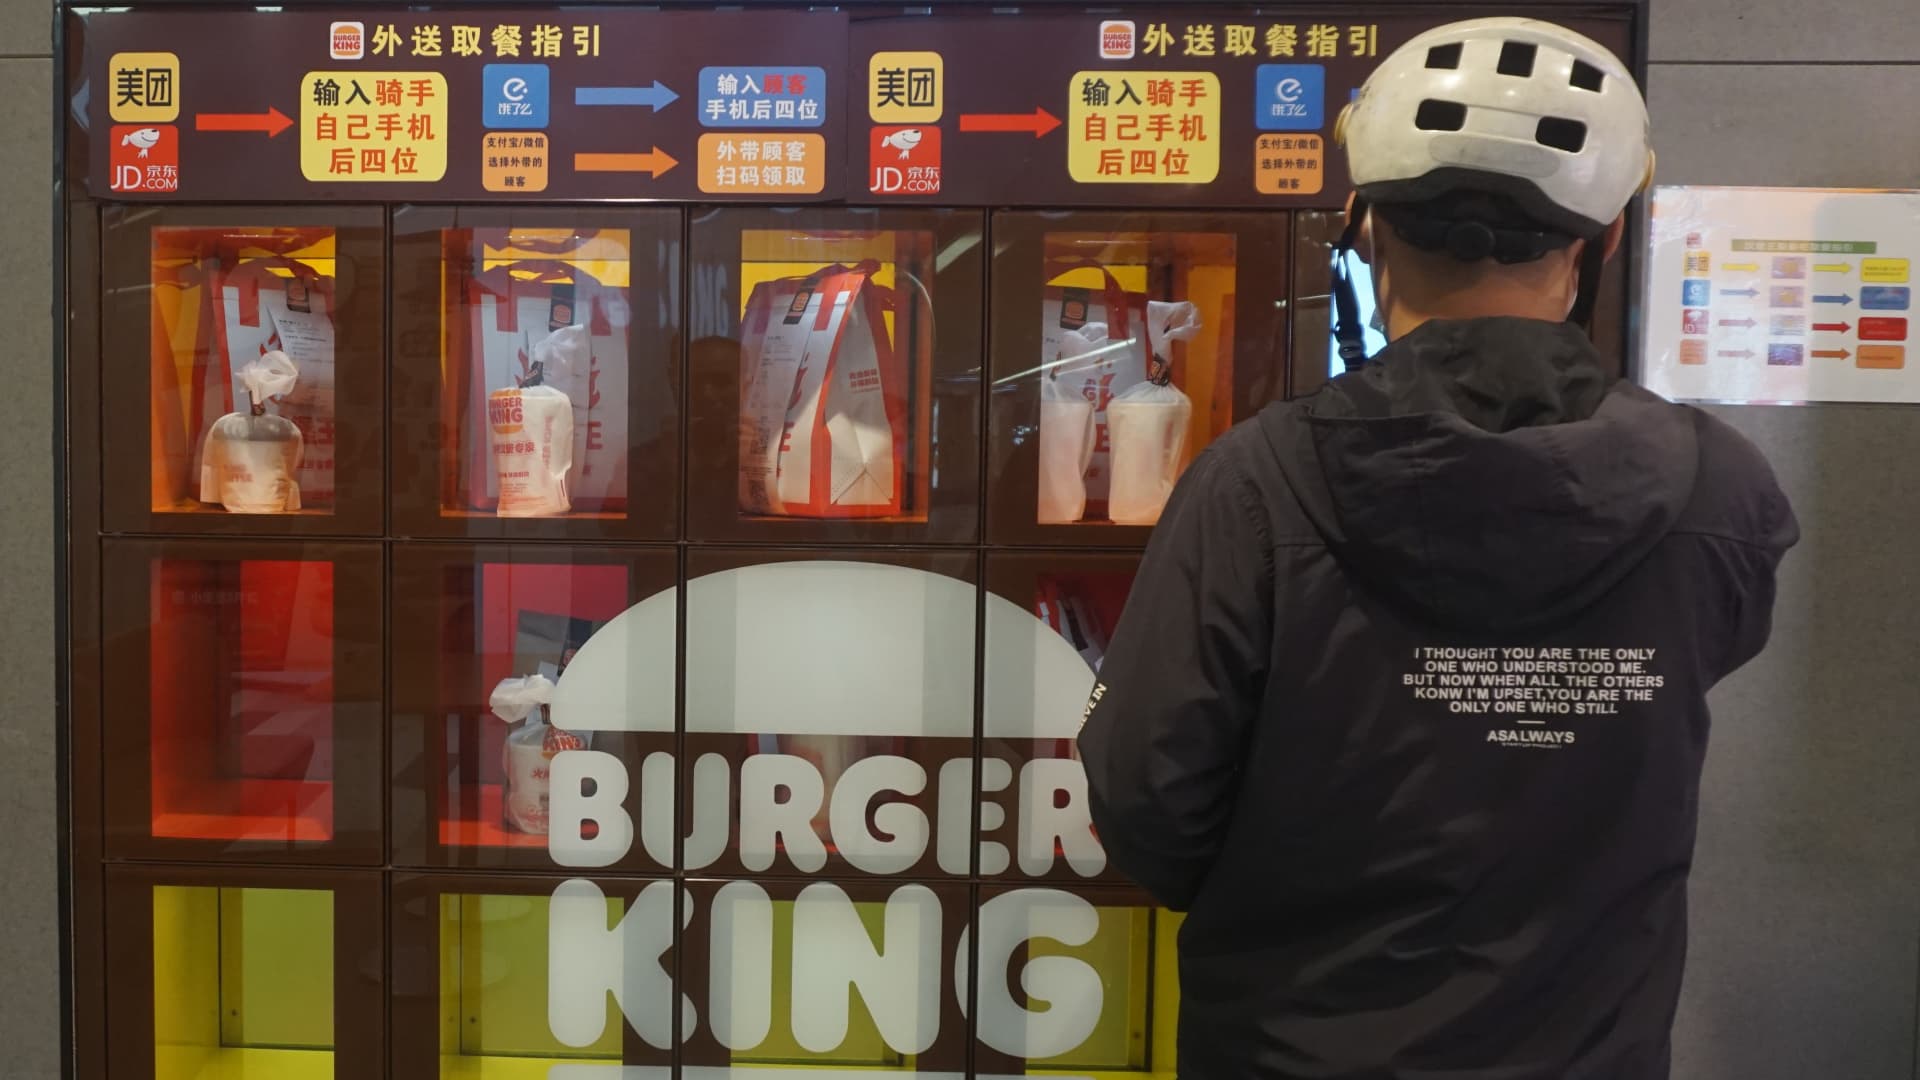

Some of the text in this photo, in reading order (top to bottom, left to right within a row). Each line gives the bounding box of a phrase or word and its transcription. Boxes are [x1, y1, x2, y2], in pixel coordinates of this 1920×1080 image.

[333, 41, 361, 50] KING
[371, 24, 600, 57] 外送取餐指引
[1103, 40, 1132, 49] KING
[1142, 23, 1378, 57] 外送取餐指引
[116, 67, 172, 107] 美团
[313, 78, 435, 107] 输入骑手
[717, 73, 807, 95] 输入顾客
[877, 67, 935, 107] 美团
[1082, 78, 1208, 107] 输入骑手
[705, 99, 818, 120] 手机后四位
[315, 113, 435, 141] 自己手机
[1084, 113, 1208, 142] 自己手机
[487, 137, 545, 149] 支付宝/微信
[716, 140, 806, 162] 外带顾客
[146, 165, 177, 178] 京东
[329, 147, 418, 175] 后四位
[488, 156, 543, 168] 选择外带的
[1097, 148, 1190, 176] 后四位
[716, 165, 806, 186] 扫码领取
[908, 166, 940, 179] 京东
[1415, 648, 1656, 661] I THOUGHT YOU ARE THE ONLY
[1425, 661, 1647, 674] ONE WHO UNDERSTOOD ME.
[1403, 674, 1664, 688] BUT NOW WHEN ALL THE OTHERS
[1415, 687, 1463, 699] KONW
[1467, 688, 1490, 700] I'M
[1586, 689, 1620, 701] ARE
[1624, 689, 1653, 701] THE
[1450, 701, 1618, 715] ONLY ONE WHO STILL
[1487, 730, 1575, 744] ASALWAYS
[548, 751, 1107, 878] BURGER
[547, 878, 1104, 1059] KING
